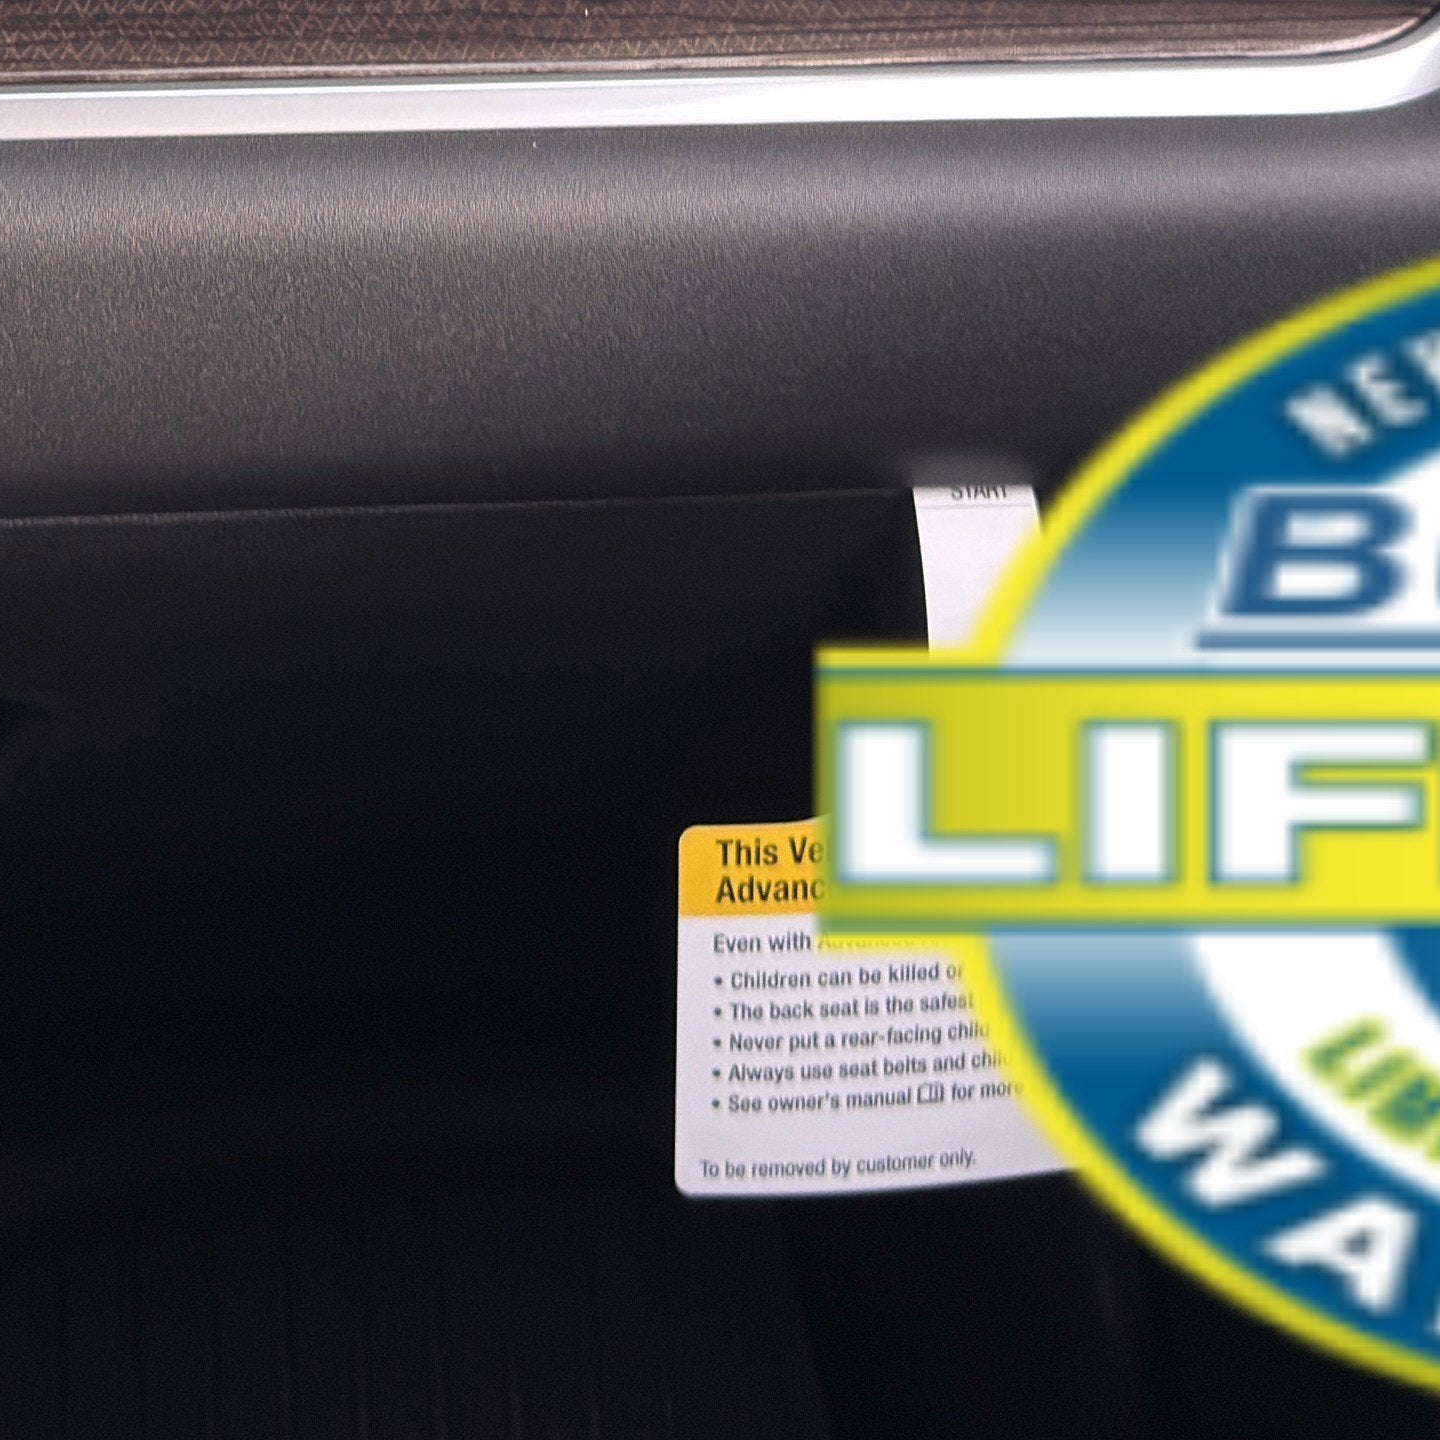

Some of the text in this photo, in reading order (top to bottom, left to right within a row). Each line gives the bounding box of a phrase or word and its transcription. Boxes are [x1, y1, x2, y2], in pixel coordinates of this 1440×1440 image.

[715, 835, 831, 867] This Ve
[715, 872, 828, 904] Advanc
[713, 933, 761, 954] Even
[768, 930, 811, 952] with
[730, 970, 811, 990] Children
[817, 971, 852, 988] can
[858, 966, 882, 985] be
[888, 961, 940, 983] killed
[730, 990, 976, 1021] The back seat is the safest
[729, 1031, 784, 1052] Never
[788, 1030, 819, 1053] put
[824, 1032, 836, 1049] a
[840, 1023, 942, 1048] rear-facing
[727, 1062, 795, 1085] Always
[800, 1063, 833, 1080] use
[838, 1058, 878, 1078] seat
[883, 1054, 927, 1077] belts
[933, 1051, 966, 1071] and
[727, 1093, 762, 1113] See
[767, 1091, 840, 1113] owner's
[846, 1086, 912, 1108] manual
[951, 1082, 976, 1101] for
[700, 1145, 977, 1179] To be removed by customer only.
